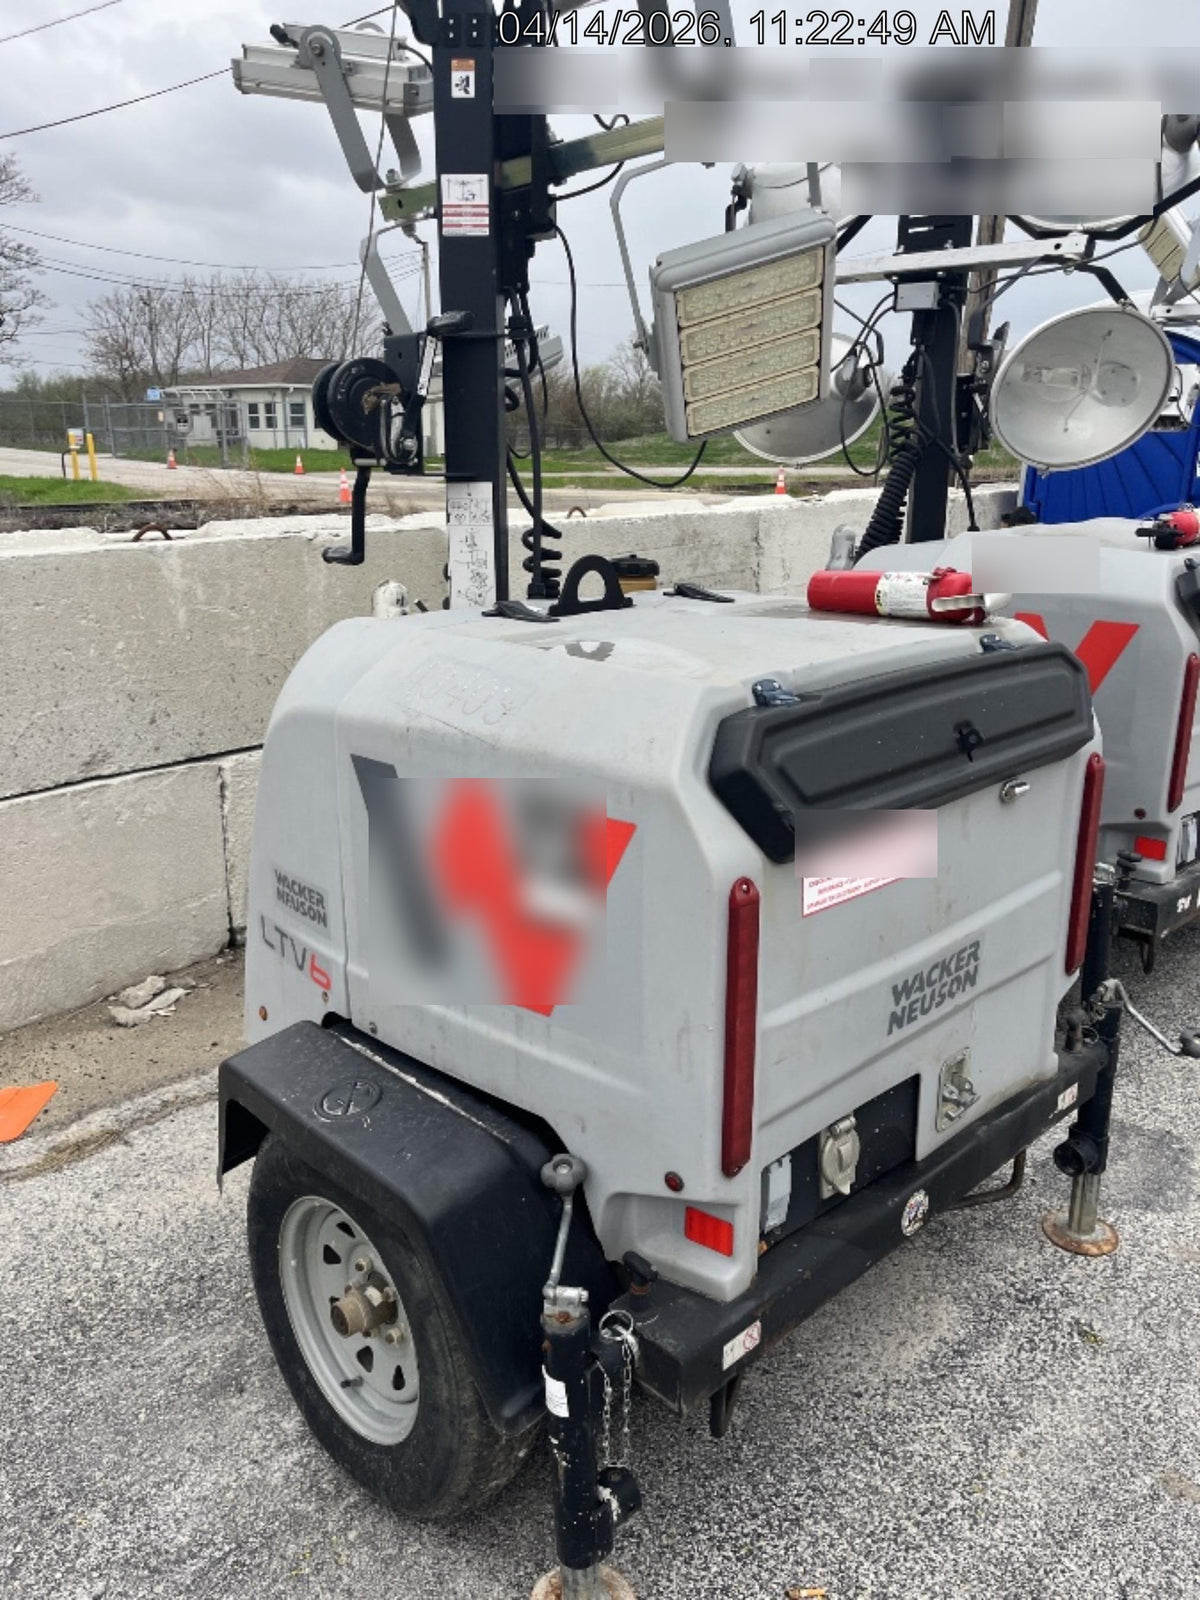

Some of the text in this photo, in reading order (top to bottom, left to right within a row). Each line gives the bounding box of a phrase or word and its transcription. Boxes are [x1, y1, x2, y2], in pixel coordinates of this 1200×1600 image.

[274, 867, 326, 910] WACKER
[276, 886, 328, 928] NEUSON
[260, 913, 331, 990] LTV6
[891, 939, 980, 1007] WACKER
[887, 963, 979, 1036] NEUSON
